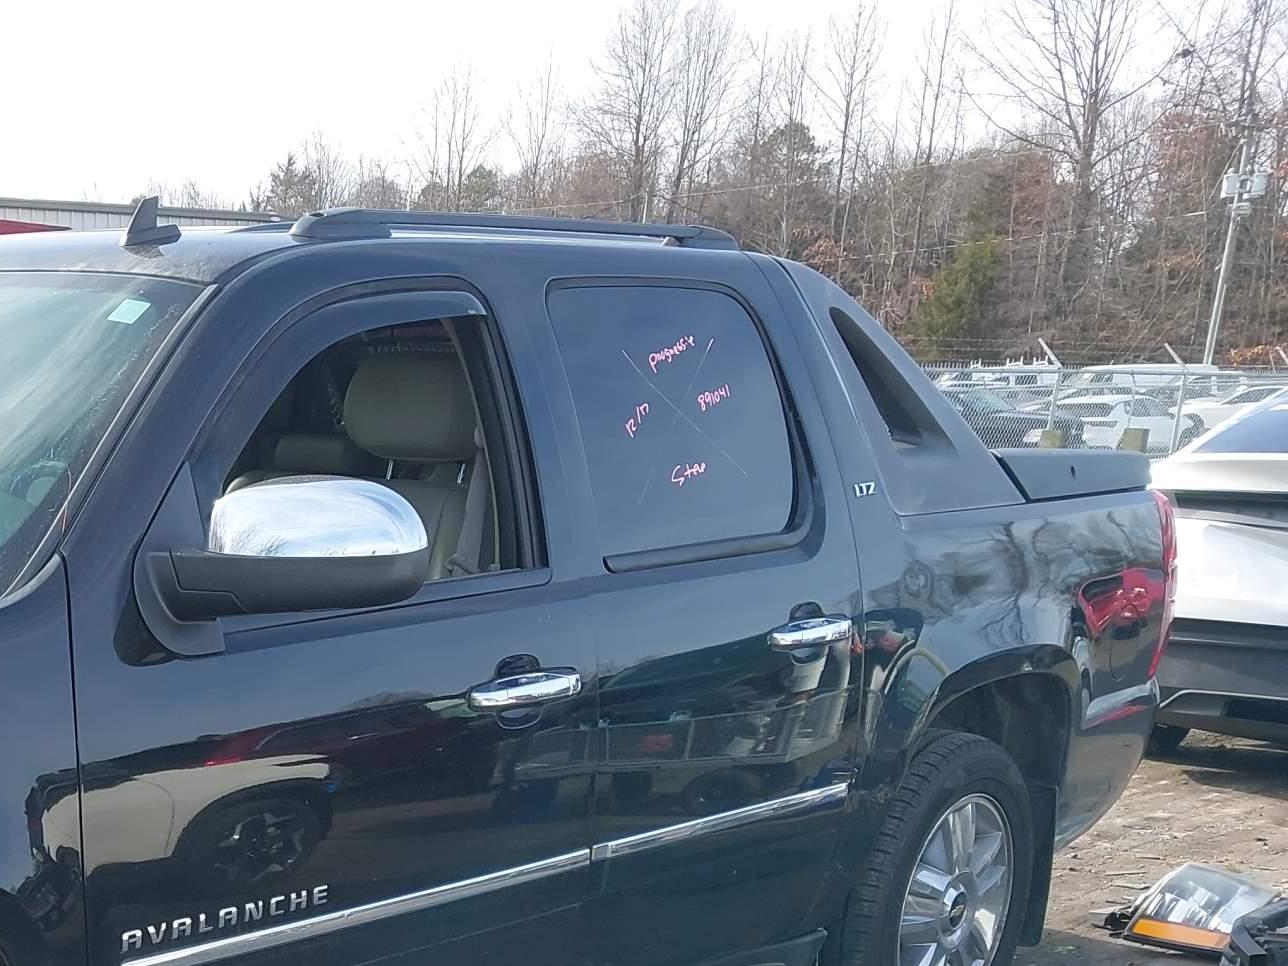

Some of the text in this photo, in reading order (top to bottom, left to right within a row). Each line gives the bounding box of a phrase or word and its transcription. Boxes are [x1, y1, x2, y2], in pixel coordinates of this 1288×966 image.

[697, 383, 731, 412] 891041
[854, 481, 877, 498] LTZ
[119, 884, 329, 954] AVALANCHE
